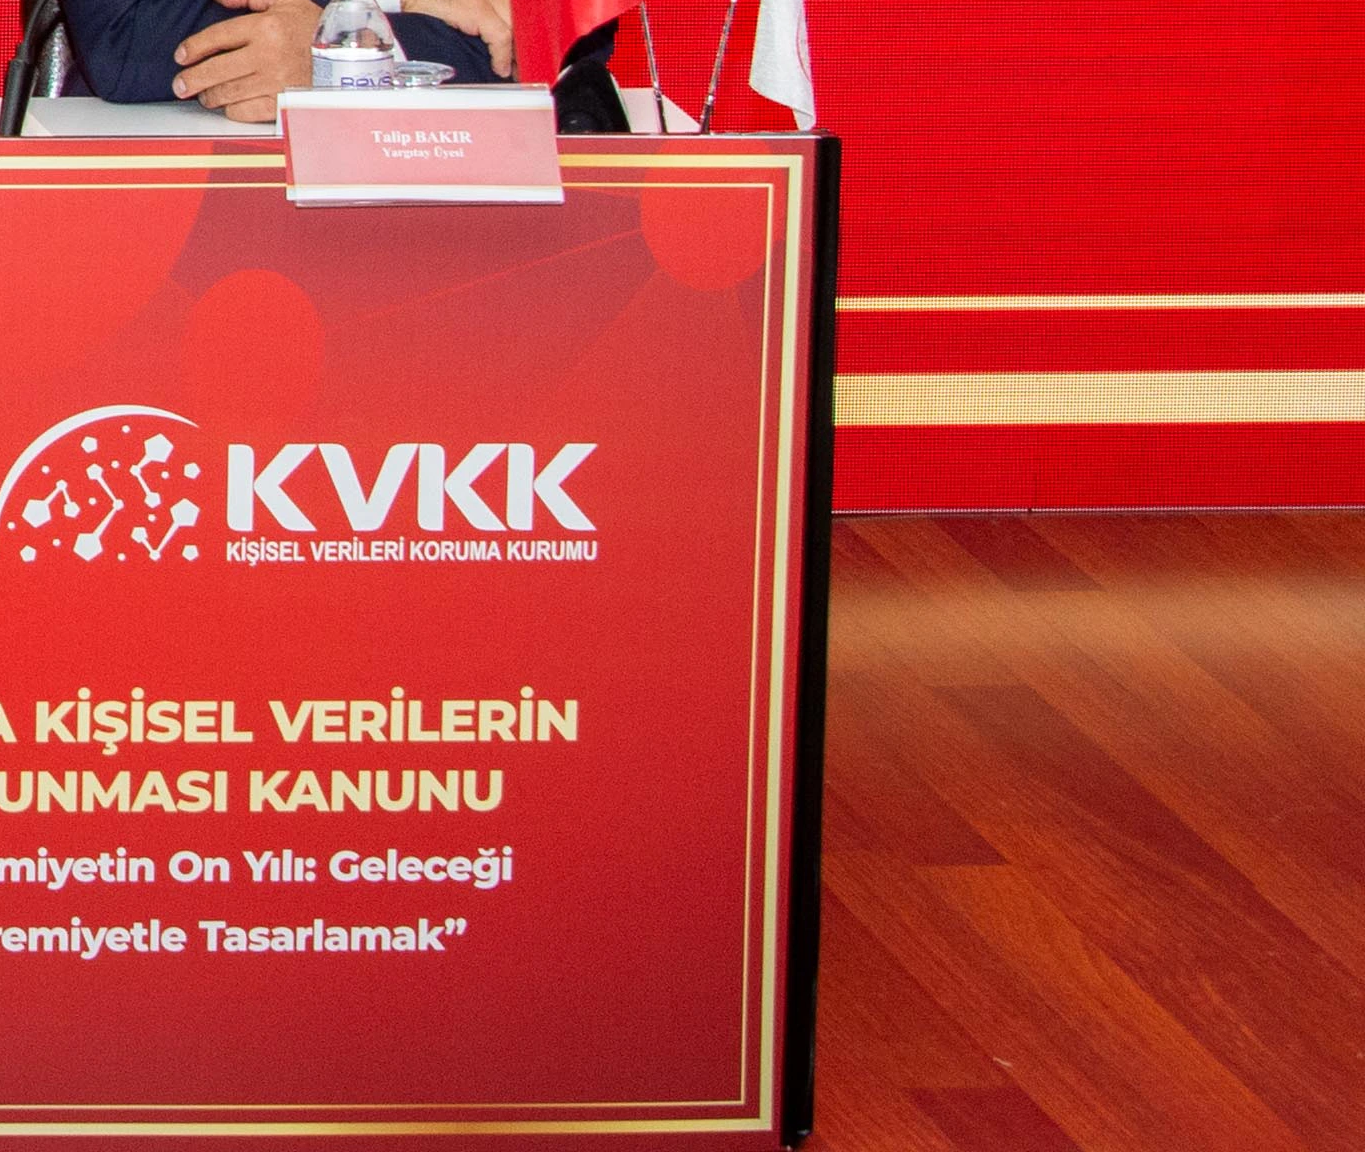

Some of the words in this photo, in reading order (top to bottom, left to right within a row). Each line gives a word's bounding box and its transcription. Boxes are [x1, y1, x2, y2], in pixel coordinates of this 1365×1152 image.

[371, 130, 411, 146] Talip
[415, 130, 473, 143] BAKIR
[227, 443, 597, 531] KVKK
[227, 537, 305, 566] KİŞİSEL
[310, 536, 404, 561] VERİLERİ
[410, 541, 501, 560] KORUMA
[507, 541, 597, 560] KURUMU
[36, 687, 253, 755] KİŞİSEL
[269, 686, 577, 742] VERİLERİN
[250, 770, 502, 811] KANUNU
[169, 851, 229, 882] On
[243, 849, 316, 881] Yılı:
[329, 846, 512, 889] Geleceği
